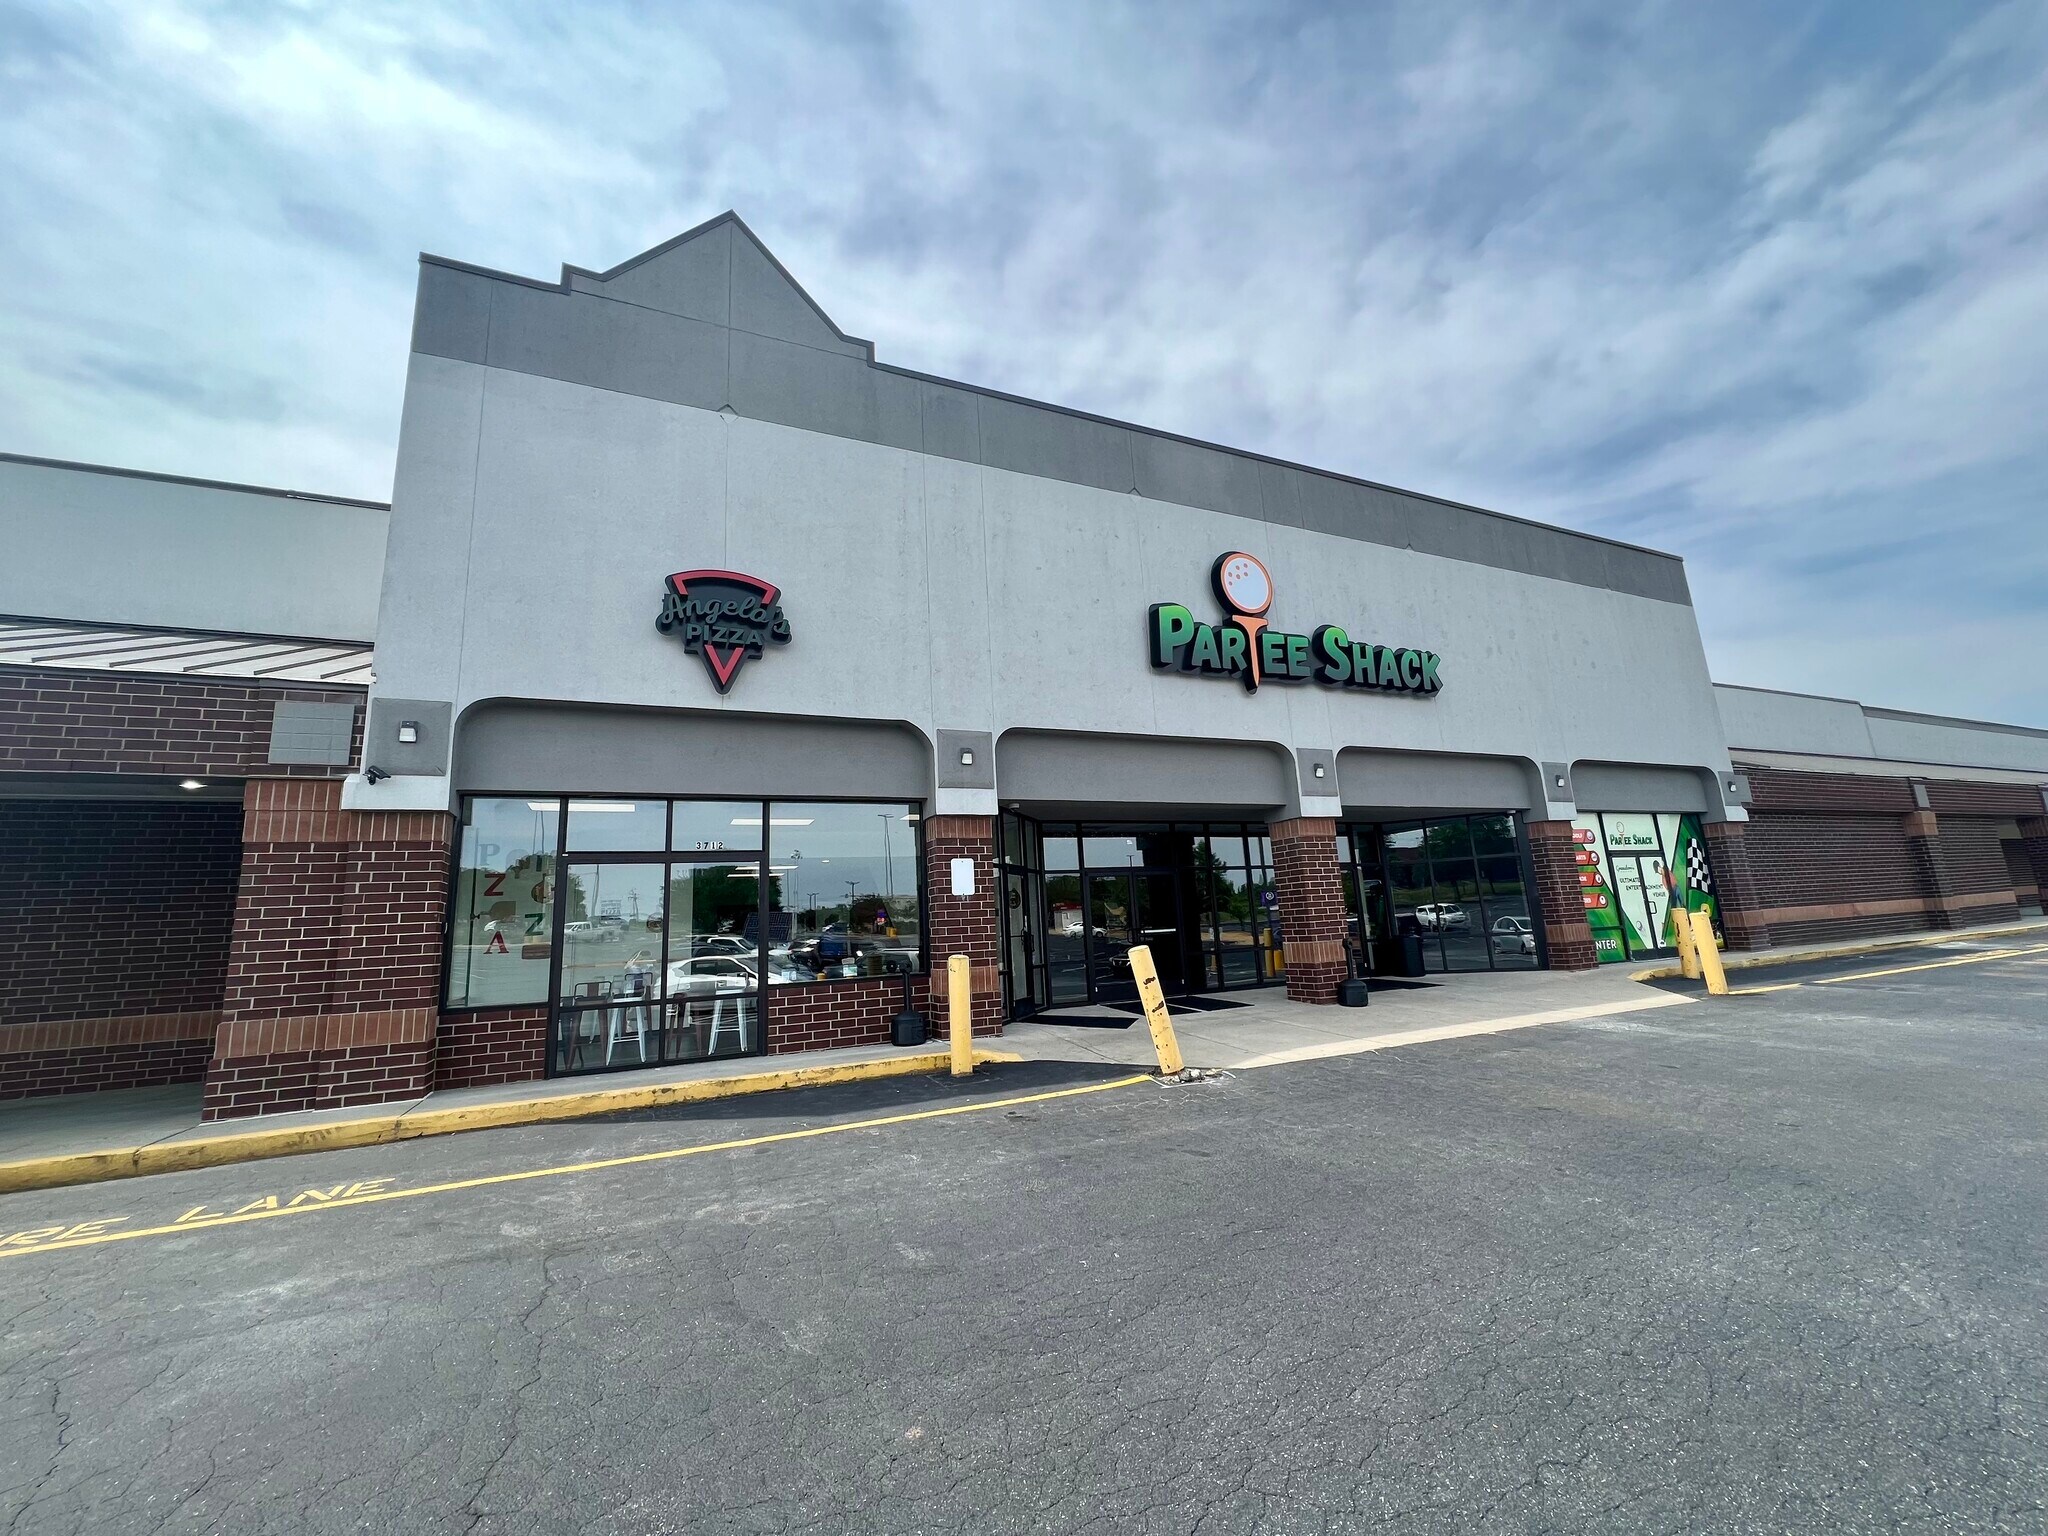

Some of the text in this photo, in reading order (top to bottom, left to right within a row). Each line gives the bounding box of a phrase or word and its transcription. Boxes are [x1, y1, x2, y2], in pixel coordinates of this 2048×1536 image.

[661, 594, 790, 635] Angelo's
[686, 623, 763, 646] PIZZA
[1322, 626, 1444, 691] SHACK
[478, 843, 500, 867] P
[695, 841, 724, 850] 3712
[484, 873, 506, 896] Z
[525, 913, 546, 936] Z
[483, 931, 509, 954] A
[0, 1178, 396, 1247] RE LANE
